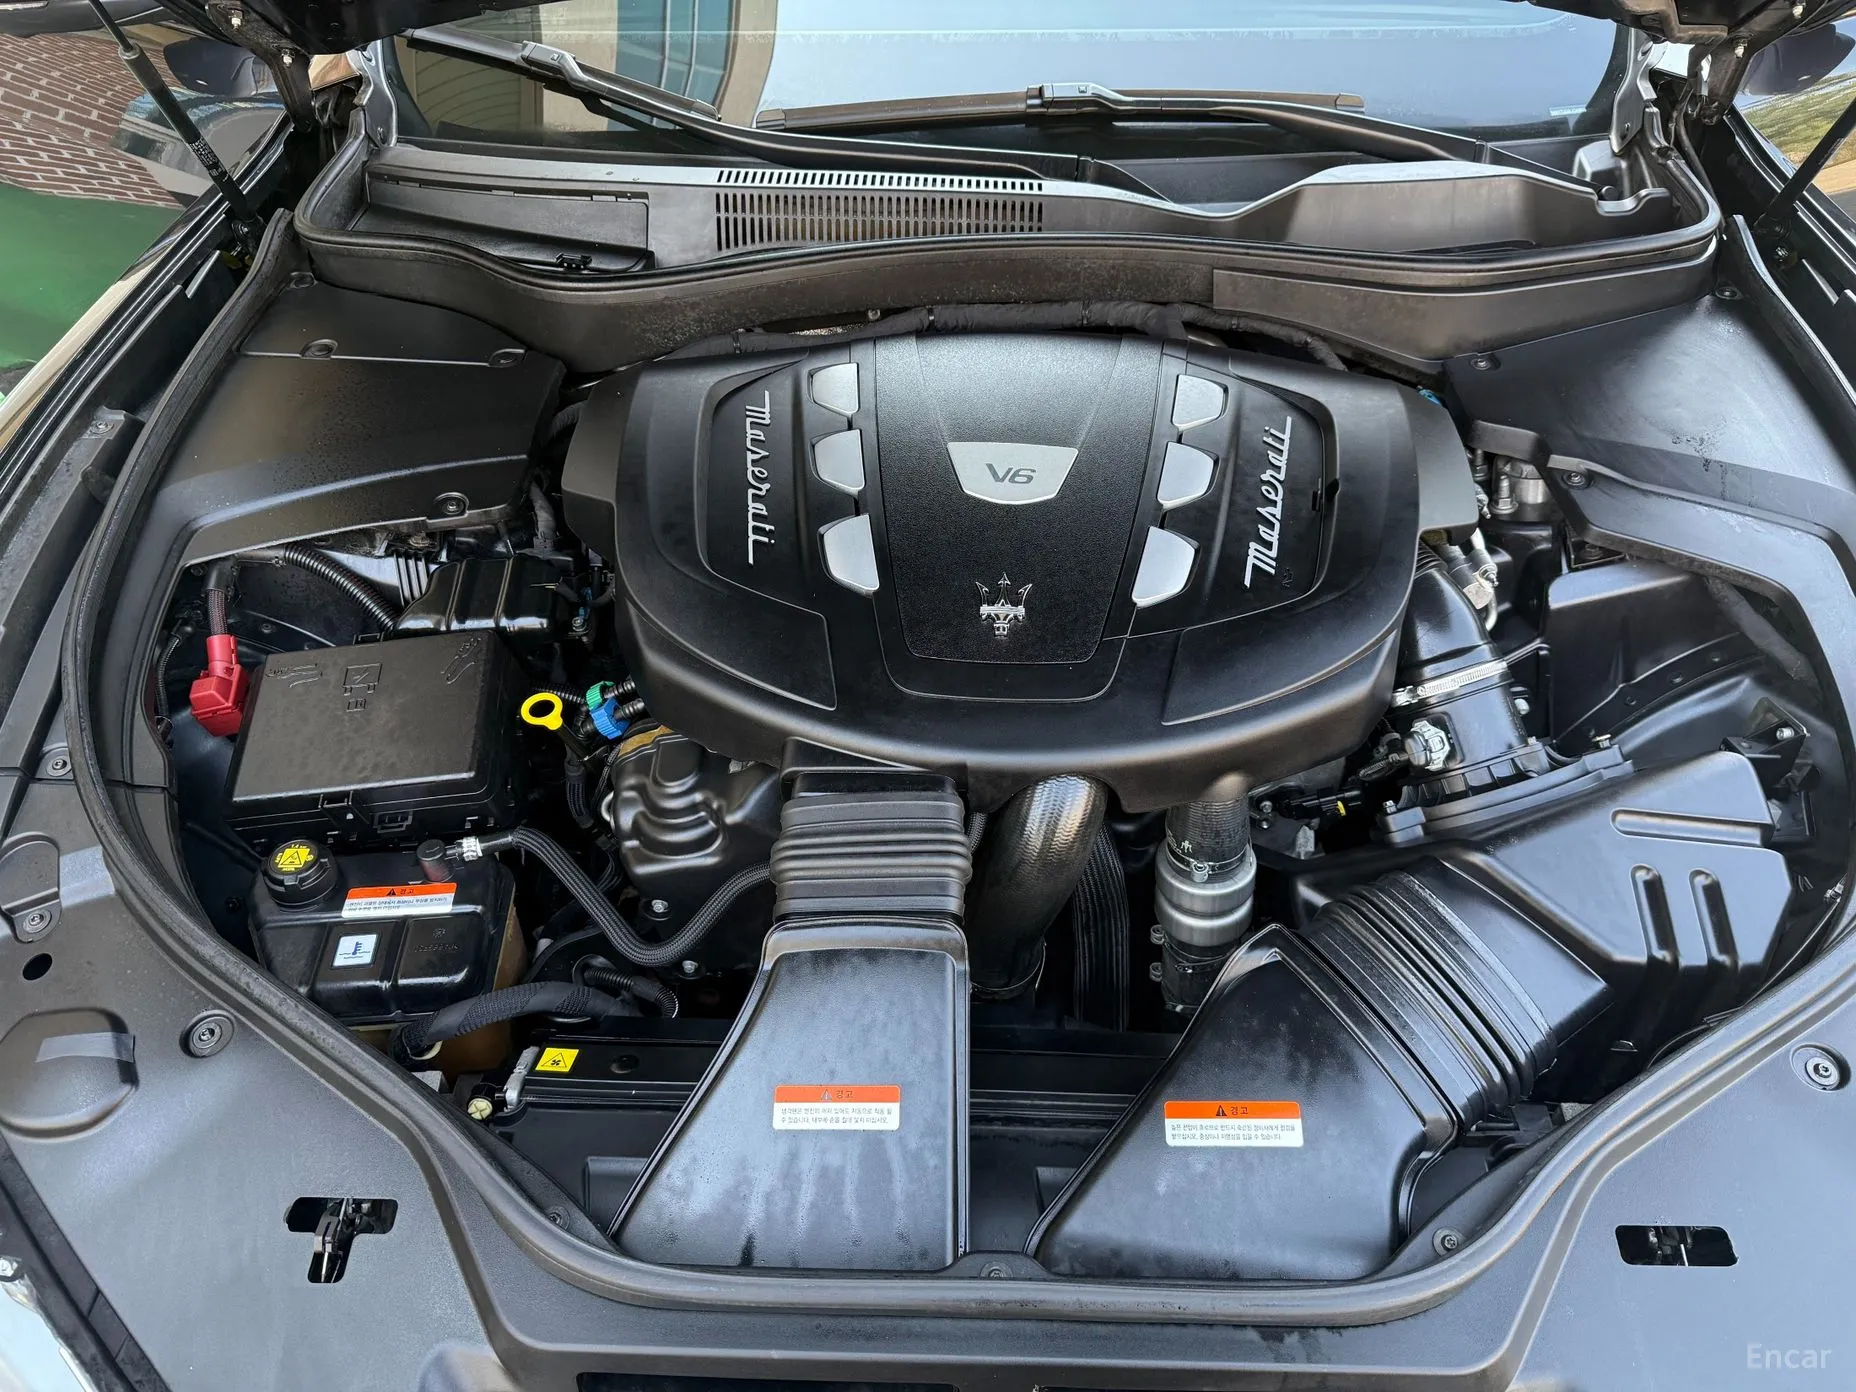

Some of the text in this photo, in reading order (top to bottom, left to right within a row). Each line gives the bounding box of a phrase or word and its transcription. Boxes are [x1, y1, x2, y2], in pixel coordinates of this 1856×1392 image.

[745, 390, 775, 565] Maserati
[985, 463, 1036, 484] V6
[1243, 416, 1292, 589] Maserati
